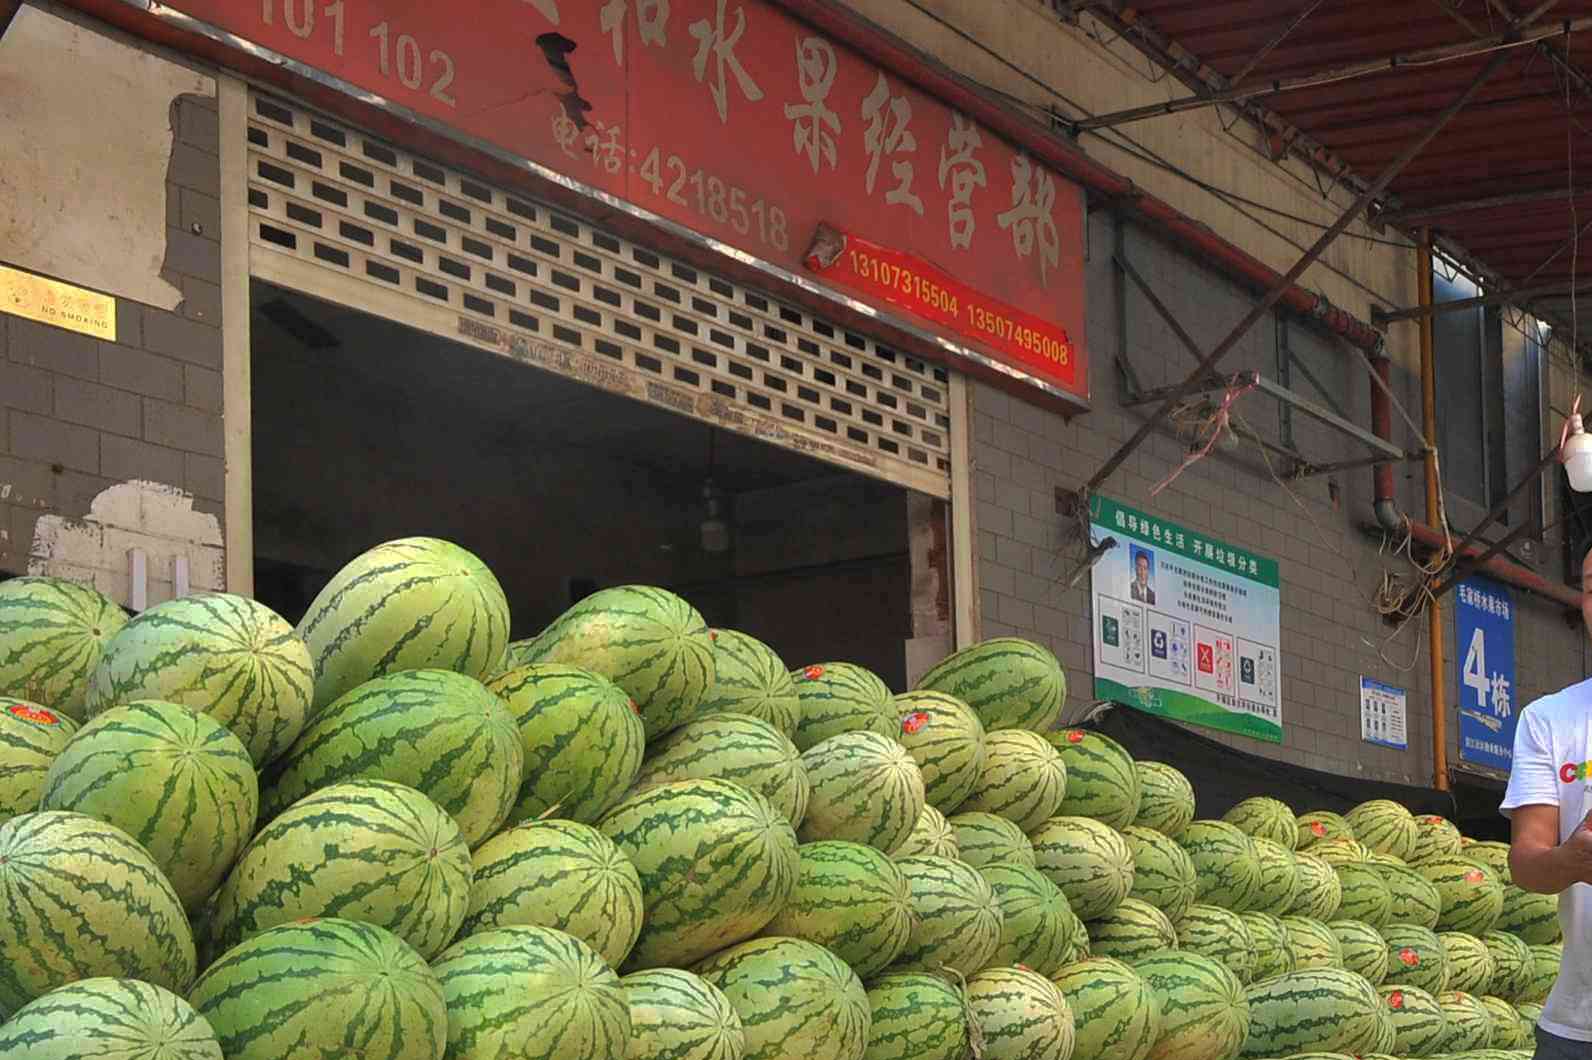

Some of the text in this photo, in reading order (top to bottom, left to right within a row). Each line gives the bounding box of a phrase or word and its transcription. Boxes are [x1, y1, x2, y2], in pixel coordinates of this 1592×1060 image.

[369, 21, 456, 108] 102
[41, 305, 57, 316] NO
[850, 250, 1070, 366] 13107315504 13507495008
[1114, 509, 1260, 577] 倡导绿色生活 开展垃圾分类
[1463, 627, 1512, 719] 4栋
